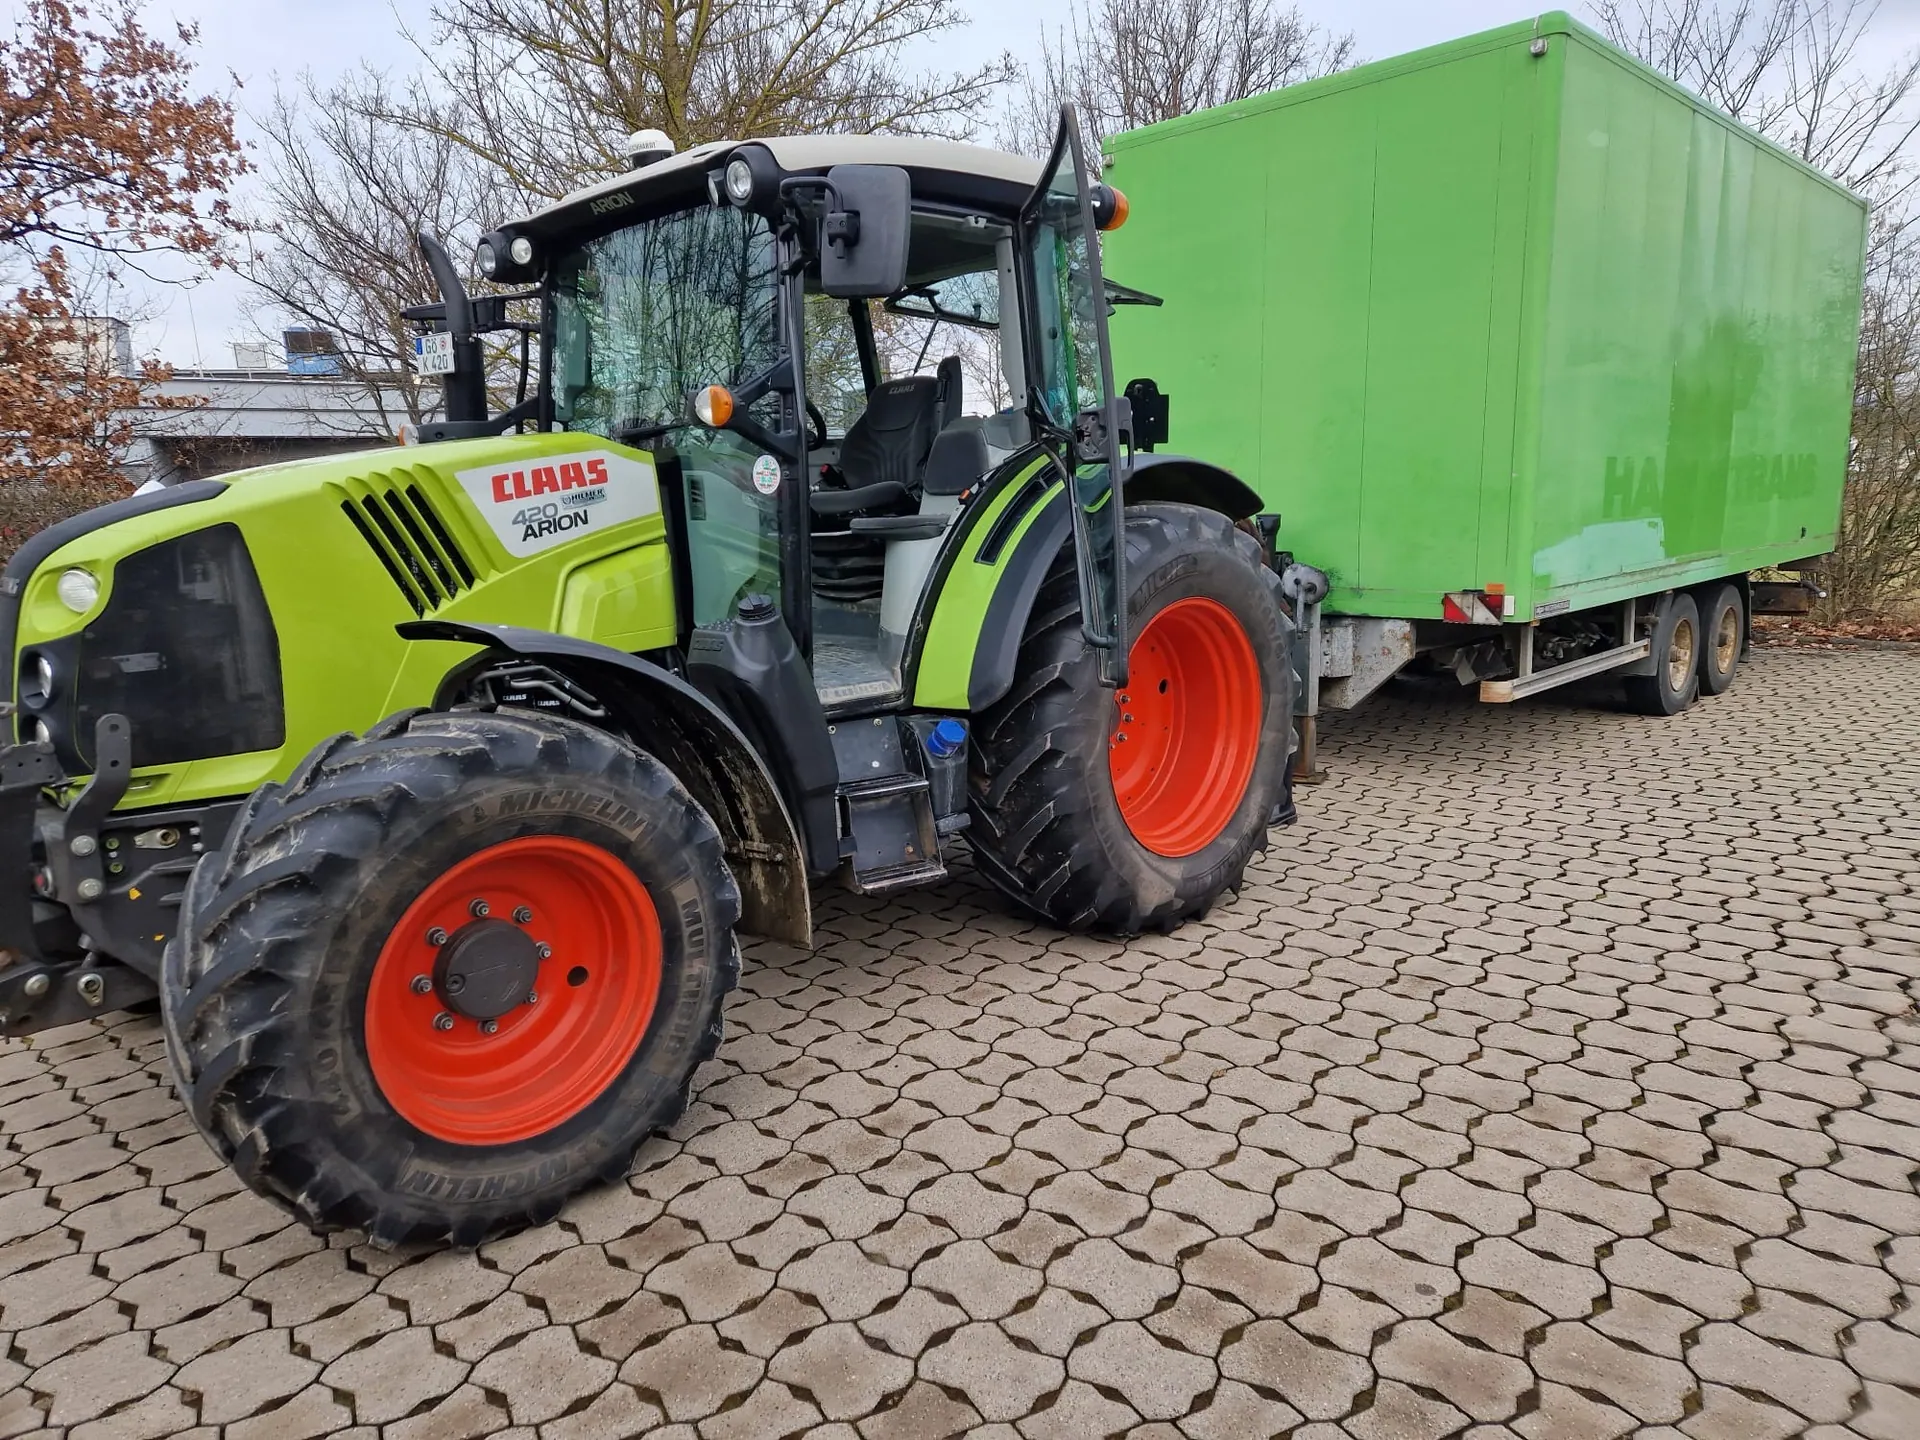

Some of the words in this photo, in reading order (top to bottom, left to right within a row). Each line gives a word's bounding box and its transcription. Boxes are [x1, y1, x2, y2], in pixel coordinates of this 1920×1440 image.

[589, 191, 635, 216] ARION
[425, 337, 438, 354] GÖ
[423, 355, 429, 372] K
[432, 354, 448, 371] 420
[491, 458, 609, 504] CLAAS
[511, 502, 559, 526] 420
[521, 509, 589, 542] ARION
[499, 790, 648, 833] MICHELIN
